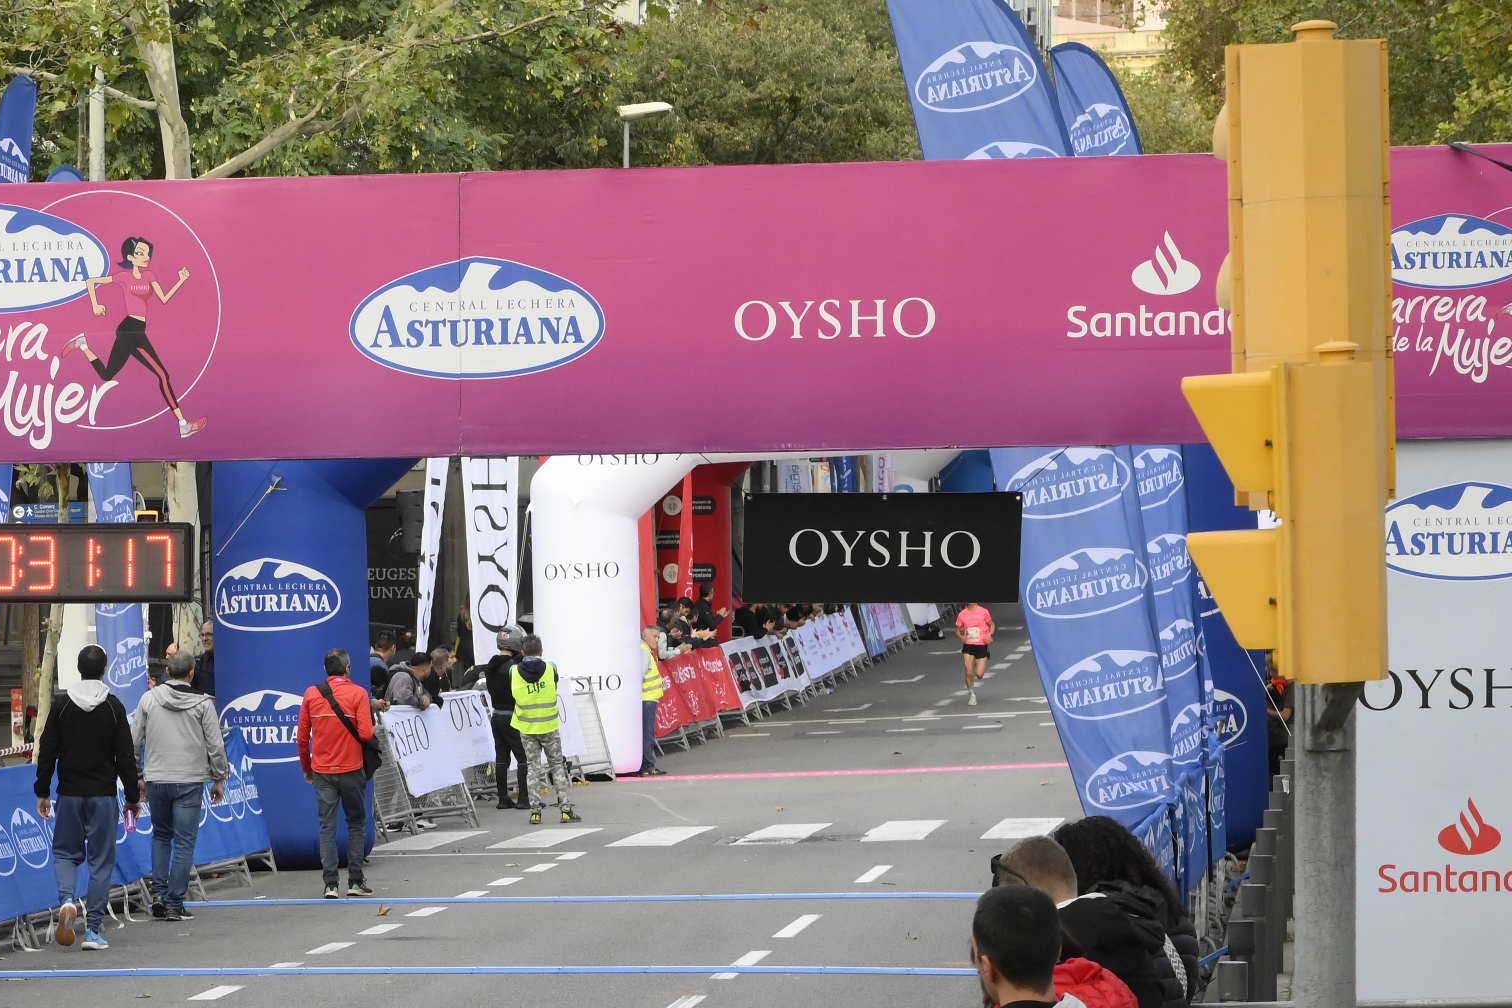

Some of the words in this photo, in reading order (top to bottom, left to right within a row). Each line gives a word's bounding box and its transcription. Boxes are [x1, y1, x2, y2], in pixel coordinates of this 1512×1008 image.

[13, 241, 85, 252] LECHERA
[409, 301, 488, 312] CENTRAL
[496, 298, 576, 310] LECHERA
[1391, 294, 1487, 323] arrera
[369, 305, 585, 348] ASTURIANA
[734, 297, 937, 341] OYSHO
[1067, 304, 1232, 338] Santand
[1415, 323, 1435, 352] la
[1429, 318, 1512, 384] Muje
[1413, 517, 1480, 526] CENTRAL
[788, 528, 981, 569] OYSHO
[545, 561, 619, 581] OYSHO
[231, 583, 274, 591] CENTRAL
[278, 583, 327, 591] LECHERA
[219, 588, 331, 615] ASTURIANA
[233, 715, 274, 723] CENTRAL
